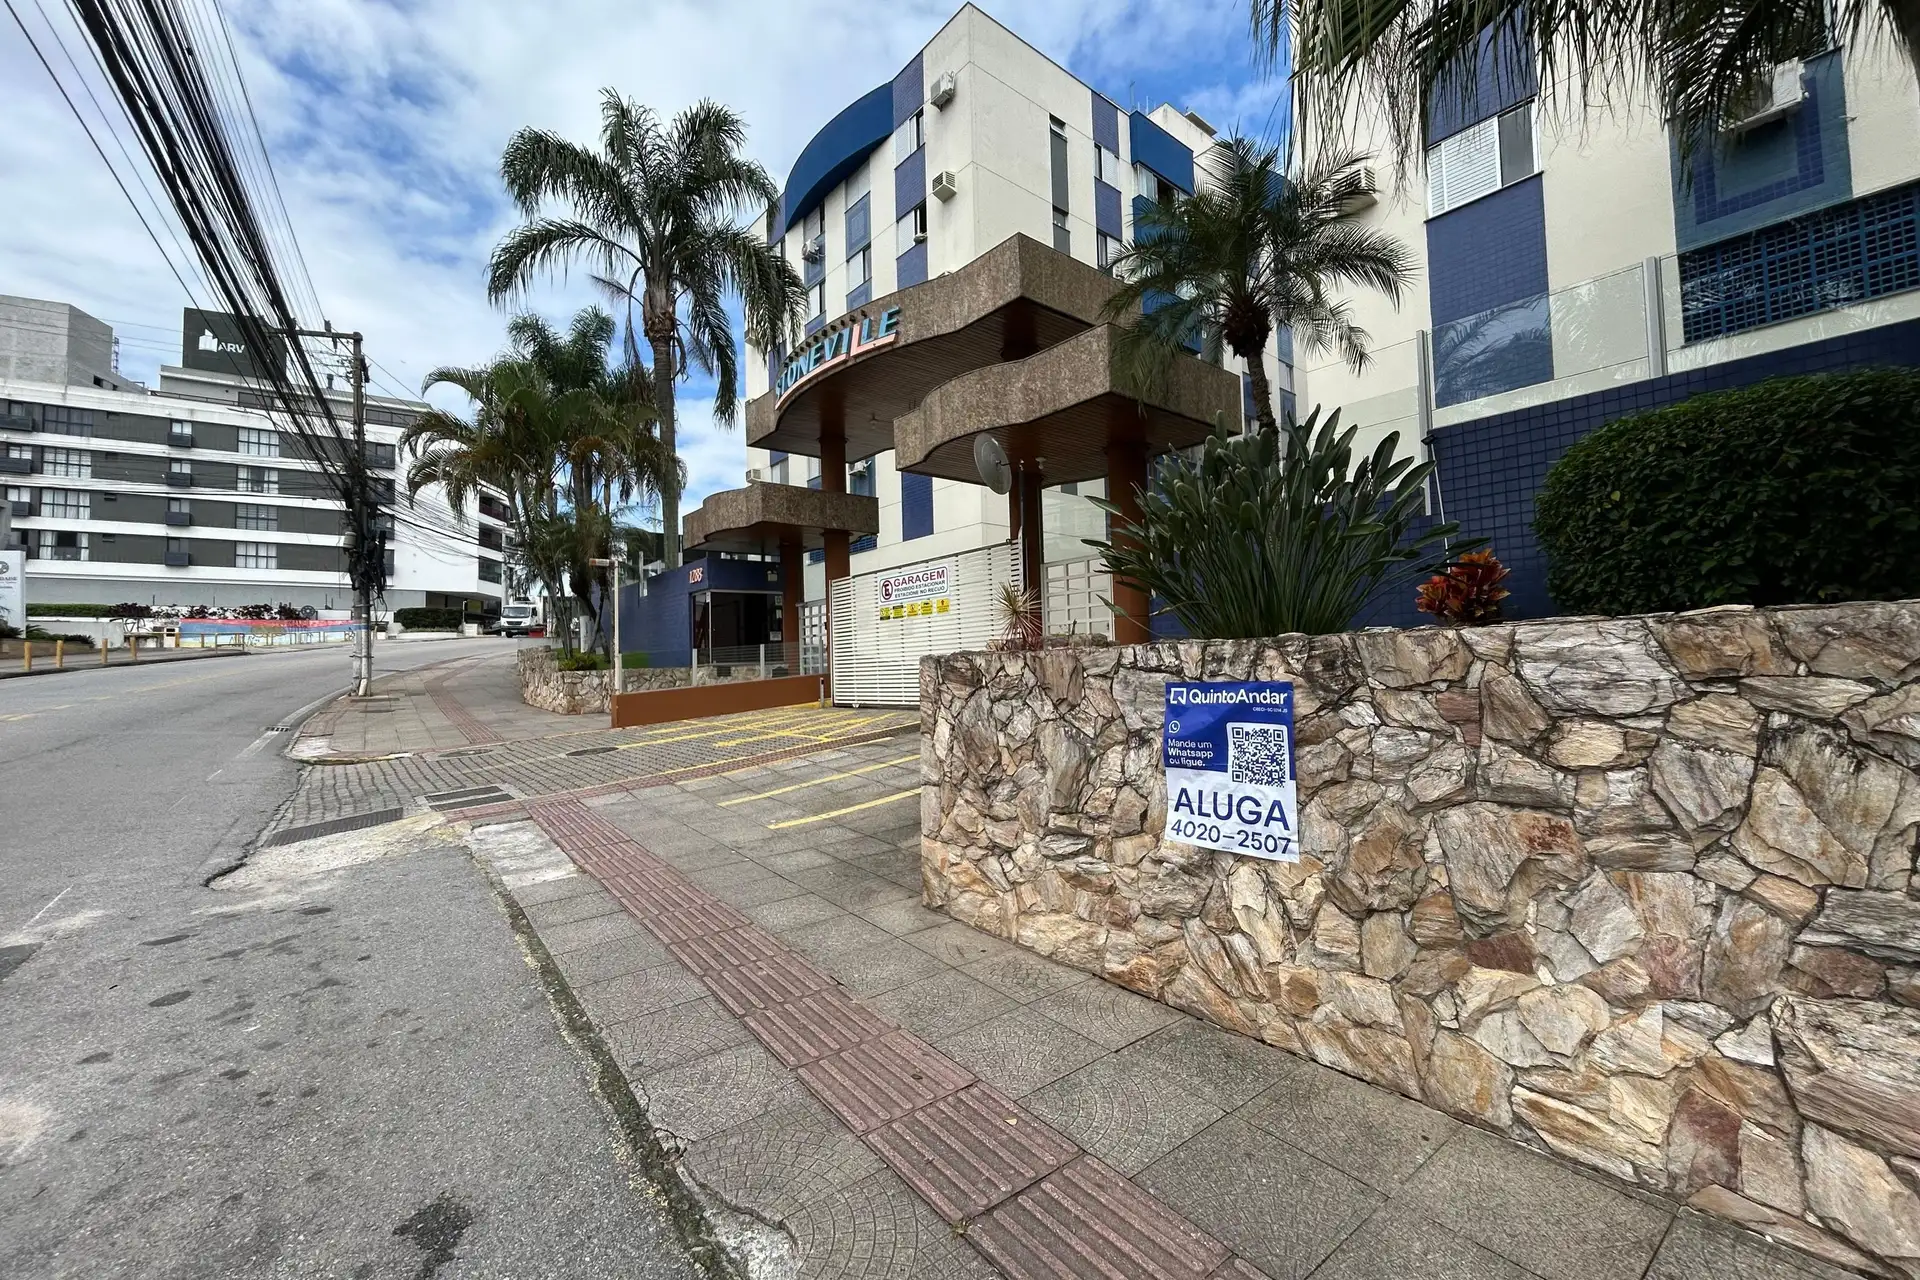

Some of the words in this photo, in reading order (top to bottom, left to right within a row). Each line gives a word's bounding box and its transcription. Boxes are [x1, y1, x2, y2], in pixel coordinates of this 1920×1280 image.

[775, 304, 900, 400] STONEVILLE
[893, 569, 945, 587] GARAGEM
[894, 585, 915, 593] PROIBIDO
[916, 580, 945, 589] ESTACIONAR
[895, 590, 919, 598] ESTACIONE
[1189, 688, 1288, 705] QuintoAndar
[1168, 739, 1196, 748] Mande
[1197, 741, 1212, 749] um
[1168, 748, 1213, 759] Whatsapp
[1181, 758, 1206, 767] ligue.
[1173, 787, 1290, 832] ALUGA
[1170, 818, 1292, 855] 4020-2507
